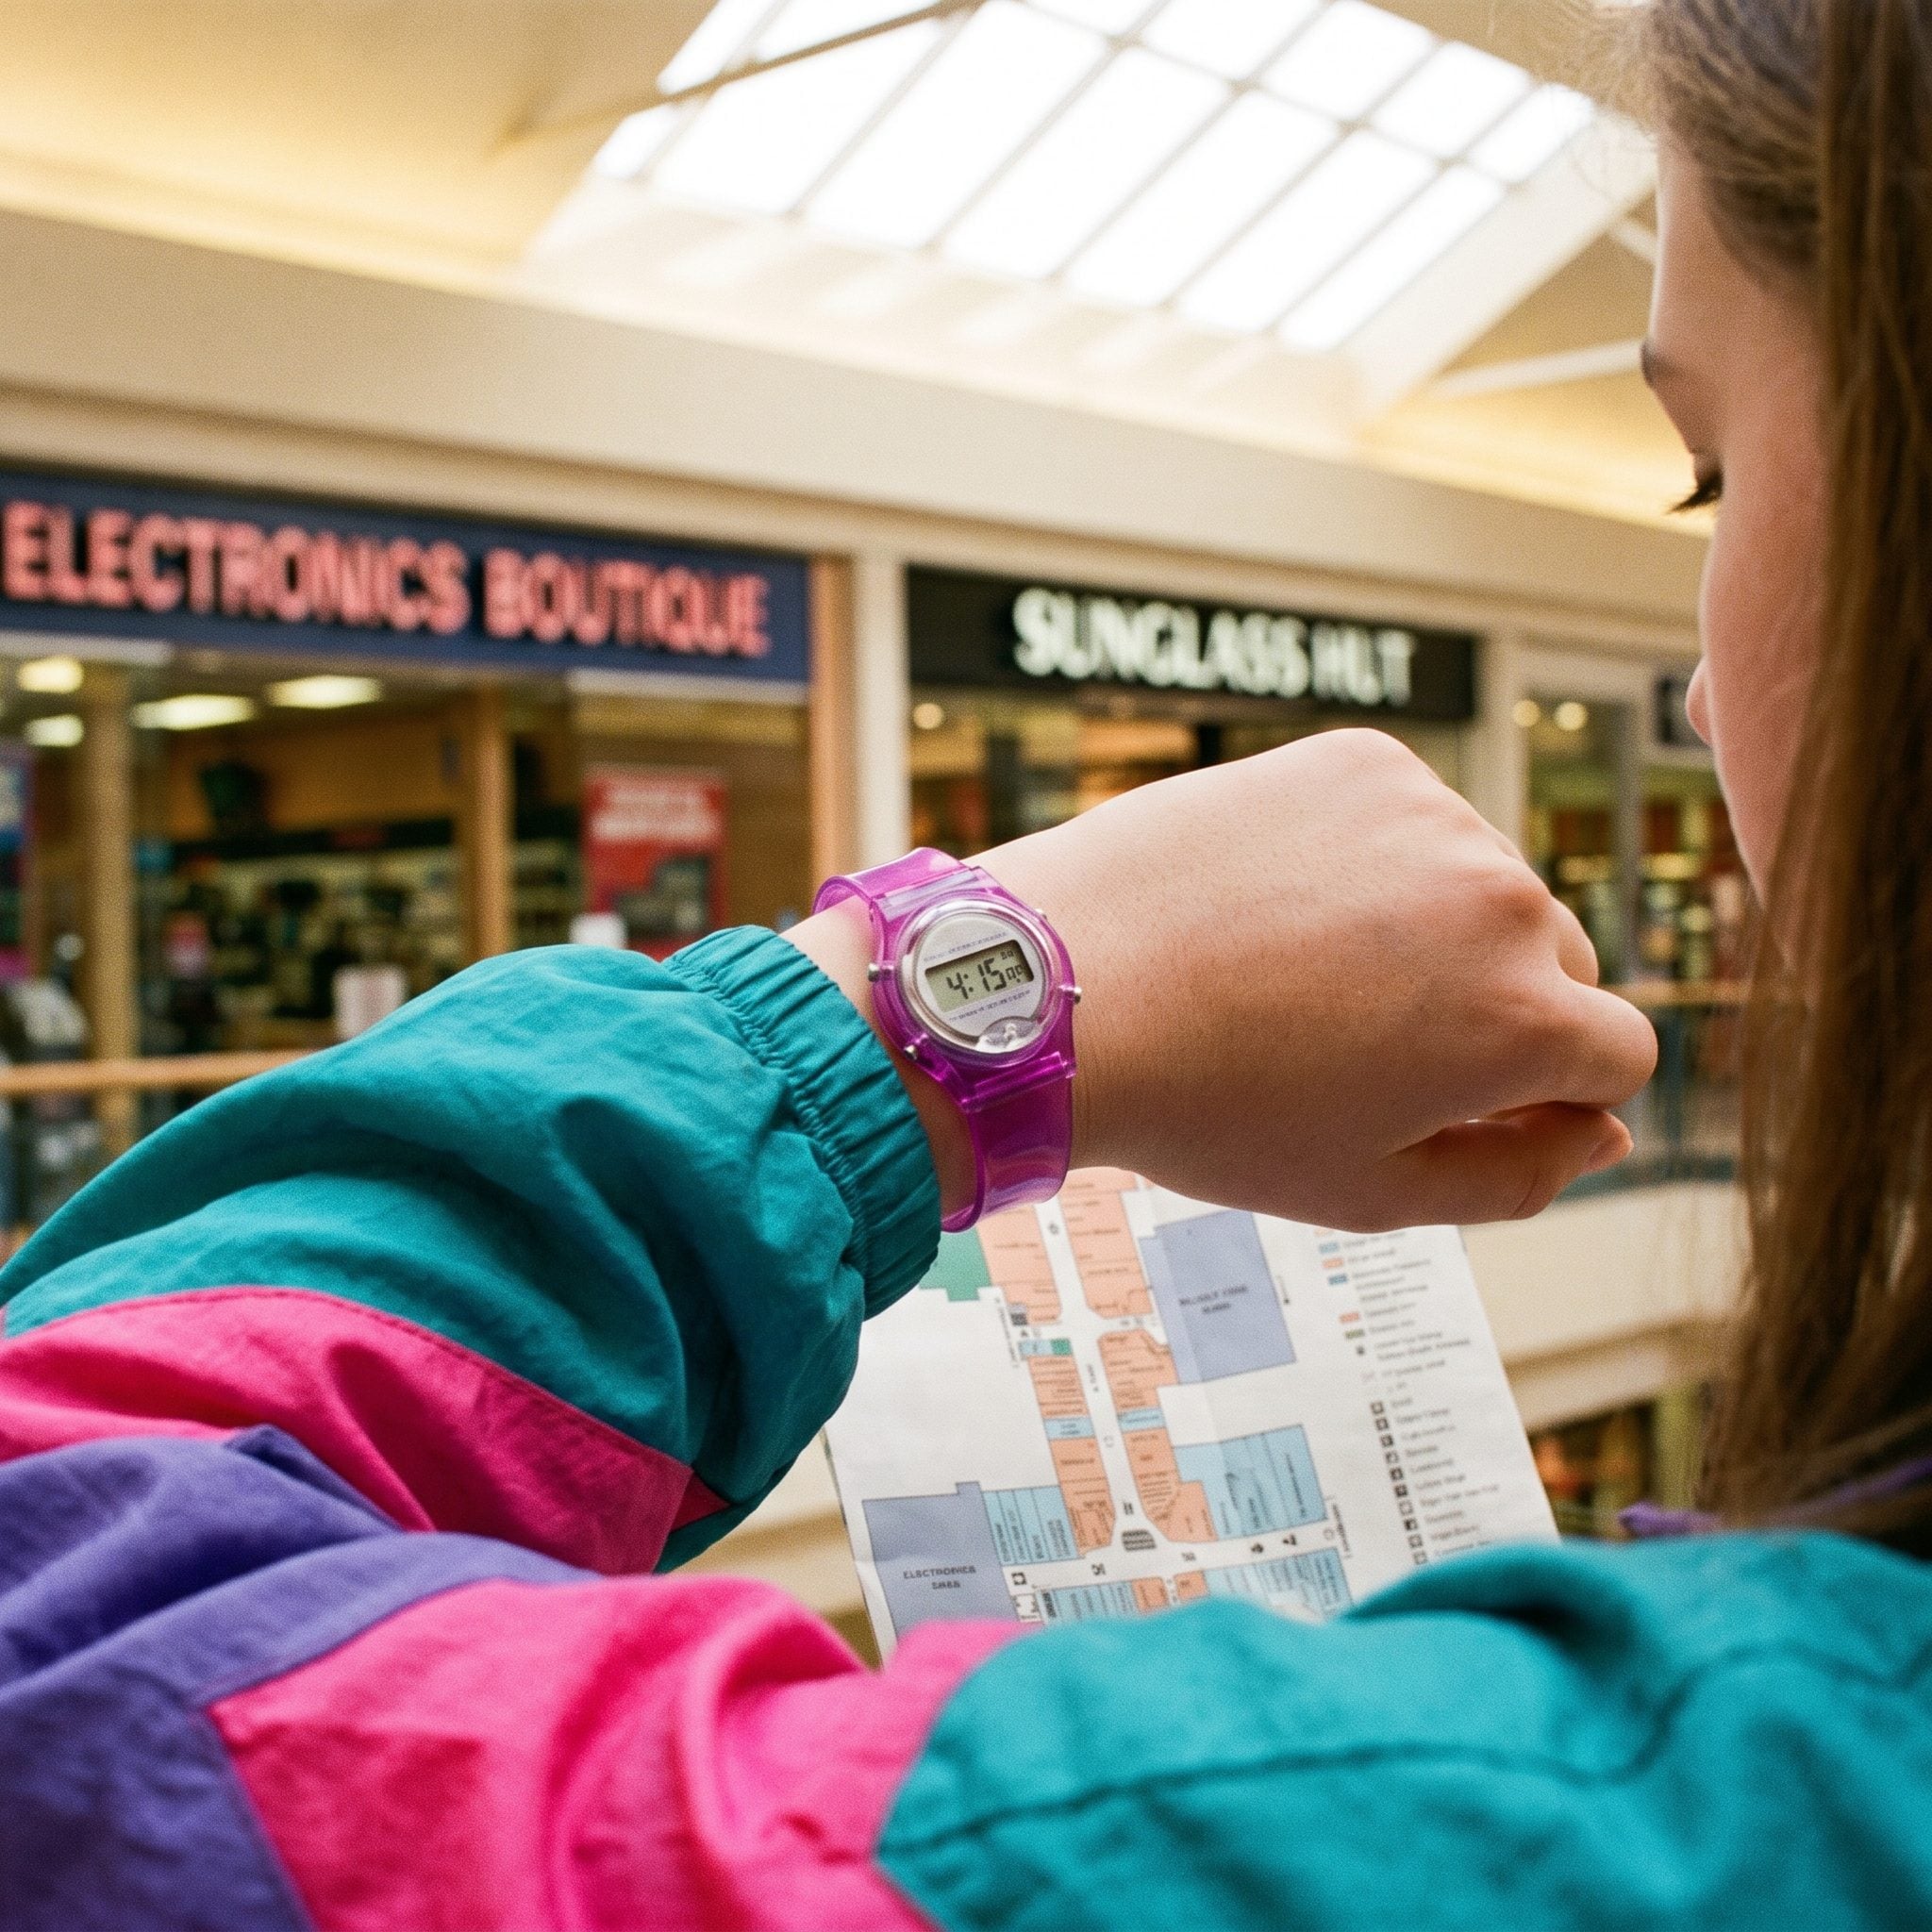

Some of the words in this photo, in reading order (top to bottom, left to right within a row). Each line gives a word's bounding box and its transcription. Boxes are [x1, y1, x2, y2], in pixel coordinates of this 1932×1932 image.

[3, 499, 470, 636] ELECTRONICS
[483, 547, 771, 659] BOUTIQUE
[1013, 587, 1309, 699] SUNGLASS
[1311, 622, 1412, 708] HUT
[946, 958, 1007, 1000] 4:15
